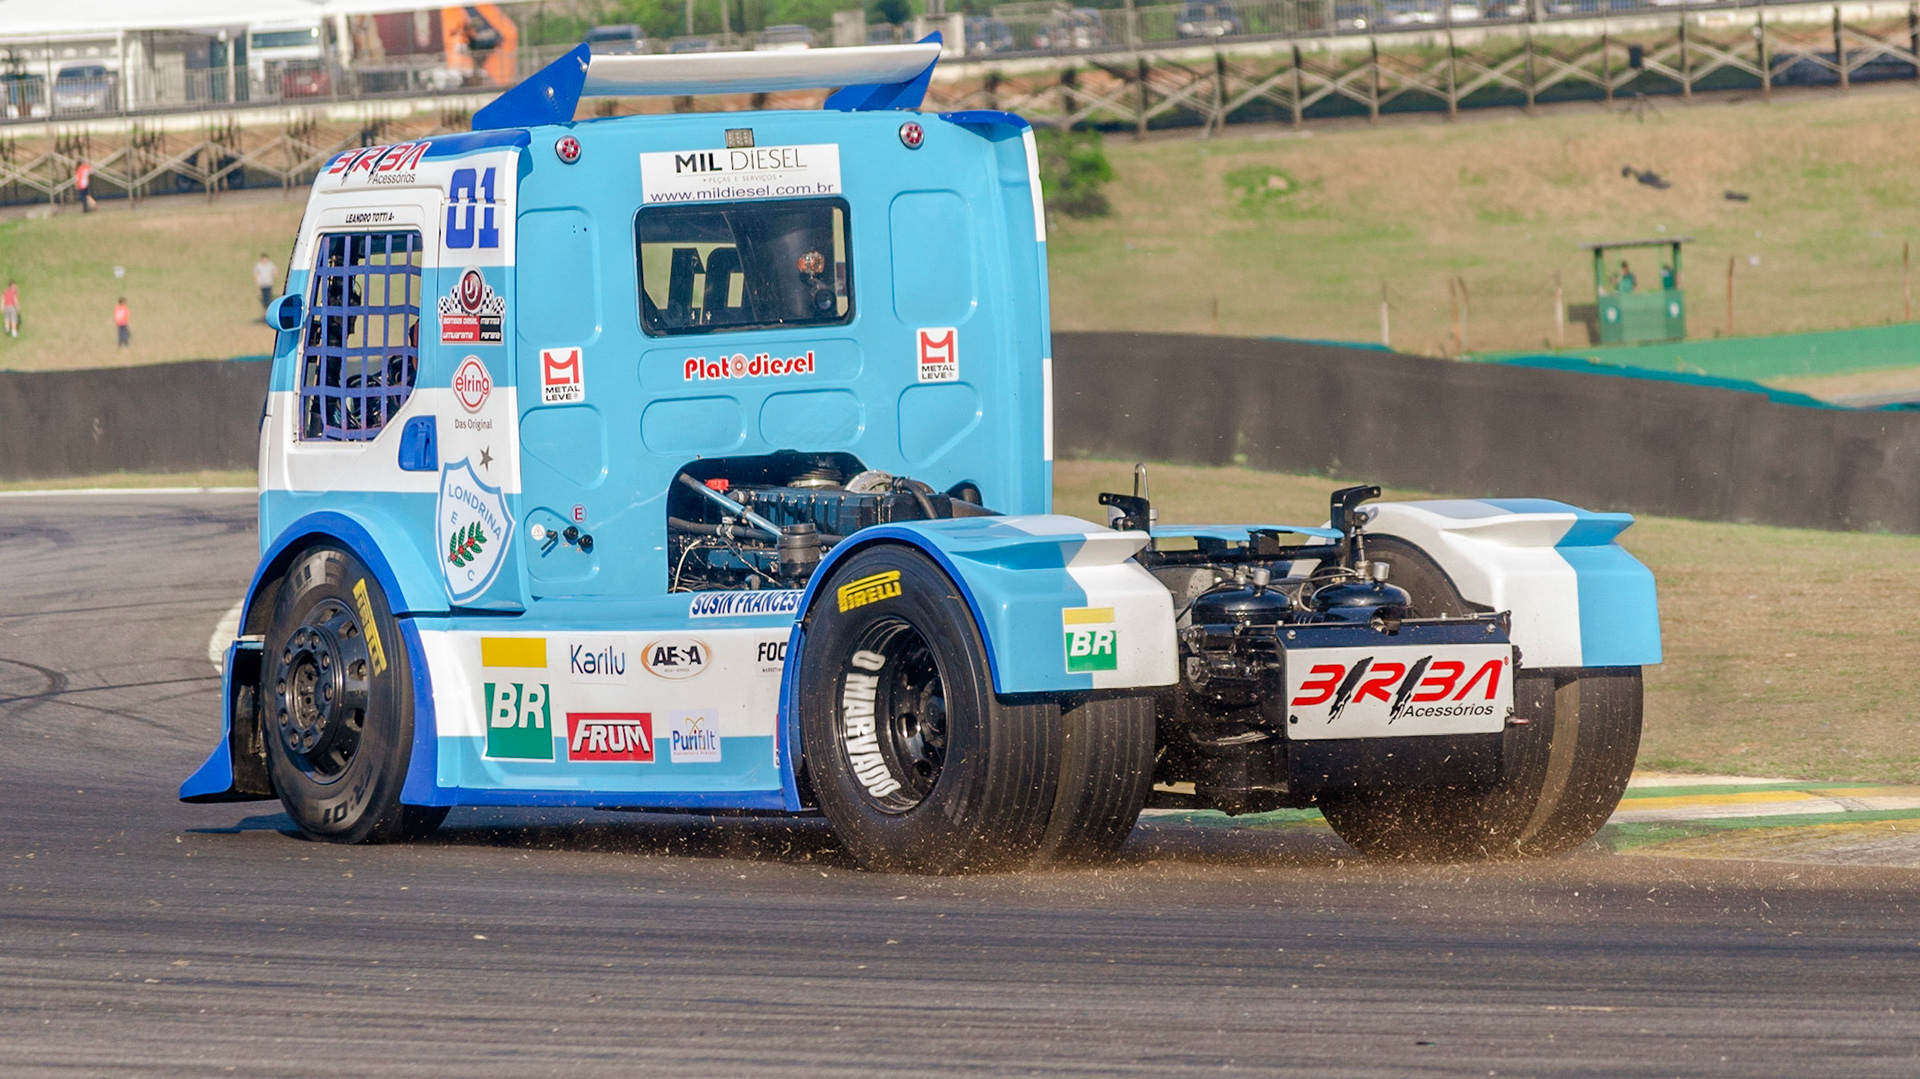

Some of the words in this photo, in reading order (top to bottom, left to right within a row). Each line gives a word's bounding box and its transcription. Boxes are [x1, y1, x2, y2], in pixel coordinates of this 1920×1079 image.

[675, 153, 723, 173] MIL
[373, 172, 416, 184] Acessórios
[650, 182, 834, 202] www.mildiesel.com.br
[446, 167, 499, 248] 01
[921, 364, 955, 372] METAL
[921, 372, 947, 380] LEVE
[455, 374, 490, 395] elring
[545, 385, 581, 394] METAL
[545, 393, 572, 402] LEVE
[454, 418, 467, 430] Das
[467, 417, 493, 432] Original
[448, 483, 502, 541] LONDRINA
[450, 511, 459, 525] E
[574, 507, 583, 521] E
[467, 569, 476, 582] C
[838, 570, 902, 613] PIRELLI
[692, 592, 738, 616] SUSIN
[352, 578, 388, 678] PIRELLI
[1069, 630, 1114, 657] BR
[570, 643, 626, 675] Karilu
[652, 645, 703, 667] AESA
[490, 682, 546, 729] BR
[1402, 703, 1494, 718] Acessórios
[571, 719, 650, 753] FRUM
[672, 729, 716, 751] Purifilt
[843, 673, 901, 798] MARVADO
